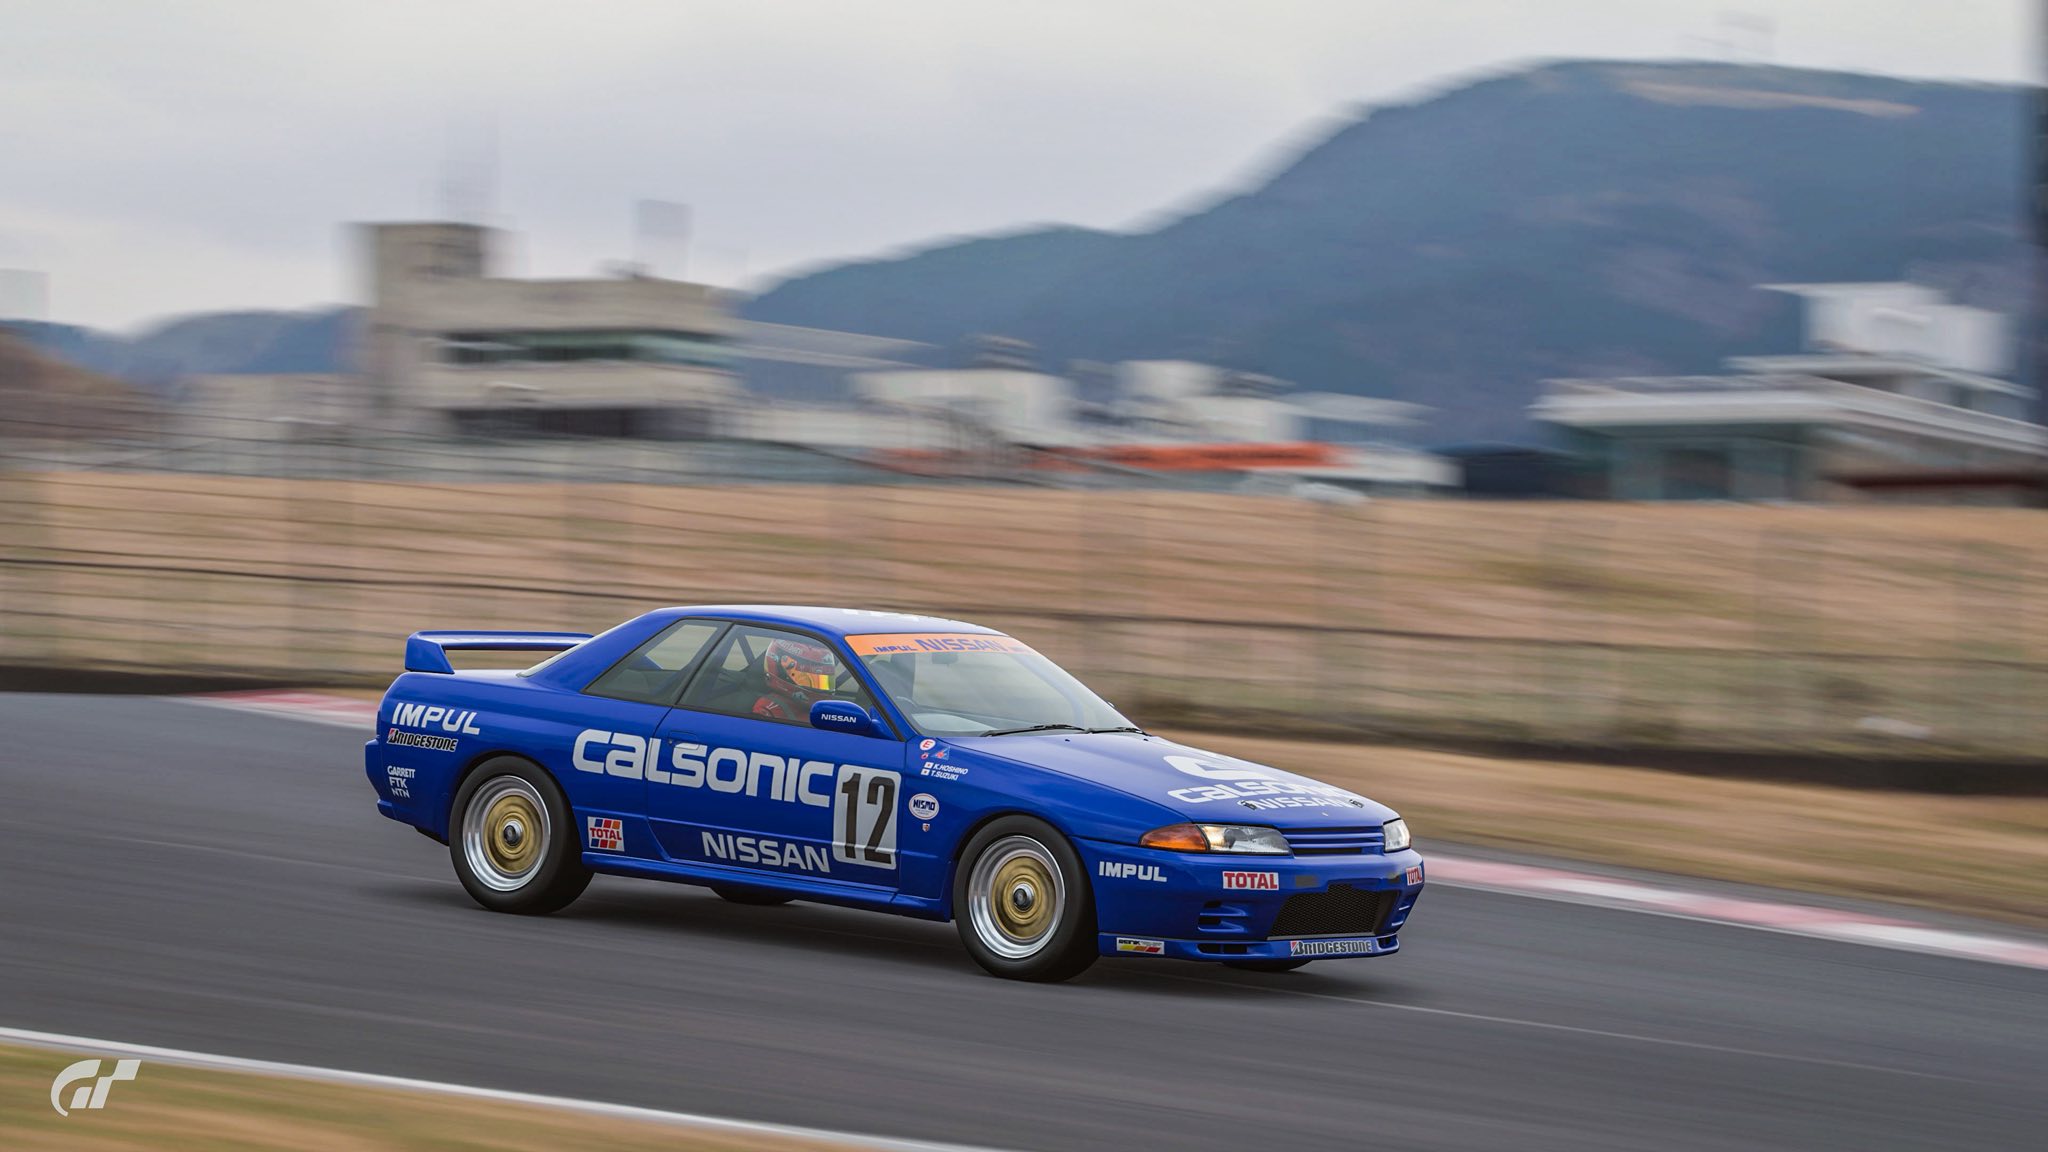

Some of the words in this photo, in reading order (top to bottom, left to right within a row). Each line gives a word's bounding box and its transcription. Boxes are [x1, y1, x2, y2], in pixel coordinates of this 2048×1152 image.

[873, 645, 917, 653] IMPUL
[914, 638, 1009, 653] NISSAN
[391, 702, 480, 735] IMPUL
[821, 713, 857, 723] NISSAN
[387, 728, 458, 752] BRIDGESTONE
[387, 765, 416, 779] GARRETT
[930, 771, 959, 781] T.SUZUKI
[933, 764, 968, 774] K.HOSHINO
[389, 777, 408, 788] FTK
[391, 788, 411, 799] NTN
[913, 800, 935, 811] NISMO
[1250, 799, 1354, 811] NISSAN
[841, 772, 896, 864] 12
[589, 826, 622, 841] TOTAL
[701, 831, 831, 873] NISSAN
[1099, 861, 1168, 883] IMPUL
[1407, 868, 1422, 884] TOTAL
[1224, 872, 1277, 889] TOTAL
[1291, 941, 1373, 956] BRIDGESTONE
